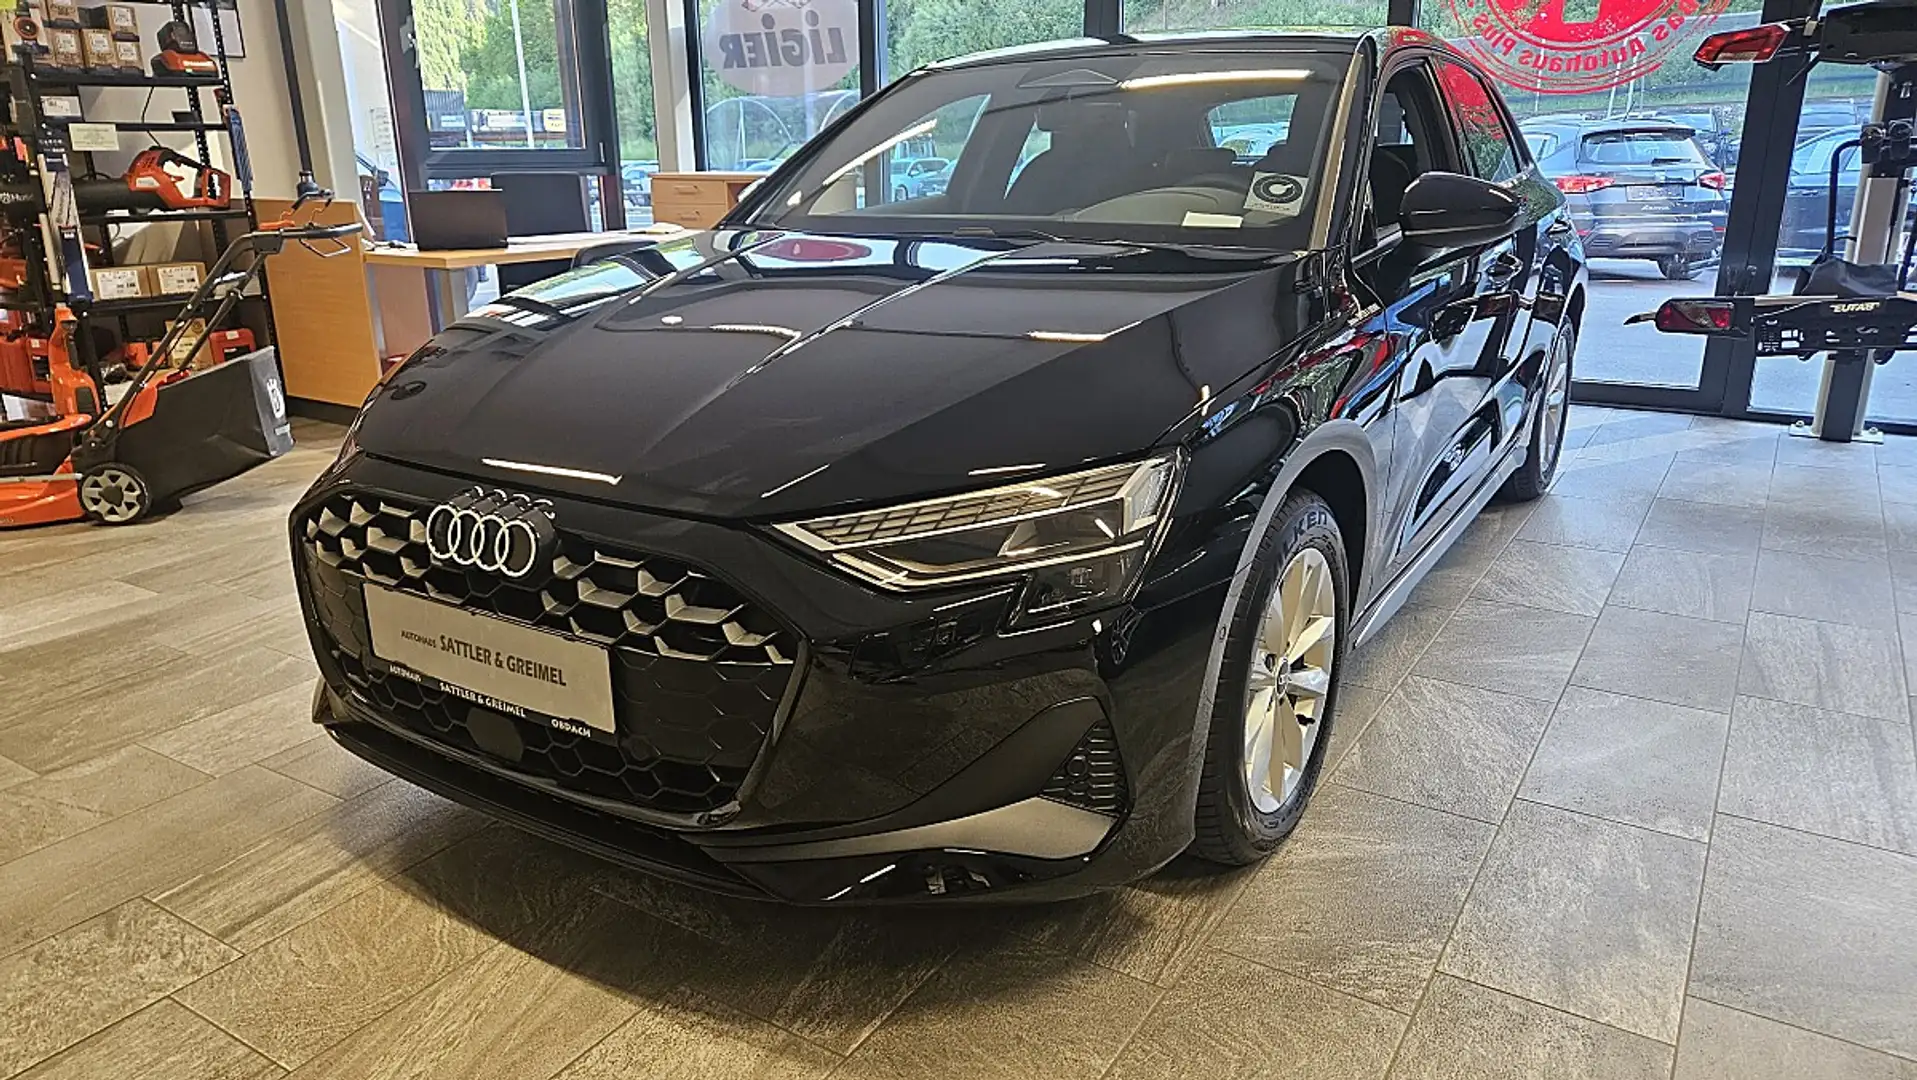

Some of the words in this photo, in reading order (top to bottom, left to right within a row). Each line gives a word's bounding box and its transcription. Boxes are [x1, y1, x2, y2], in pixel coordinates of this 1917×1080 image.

[401, 629, 437, 649] AUTOHAUS
[439, 635, 493, 666] SATTLER
[493, 651, 505, 669] &
[506, 654, 567, 687] GREIMEL
[439, 682, 476, 702] SATTLER
[477, 693, 485, 705] &
[485, 696, 527, 719] GREIMEL
[550, 718, 592, 738] OBDACH
